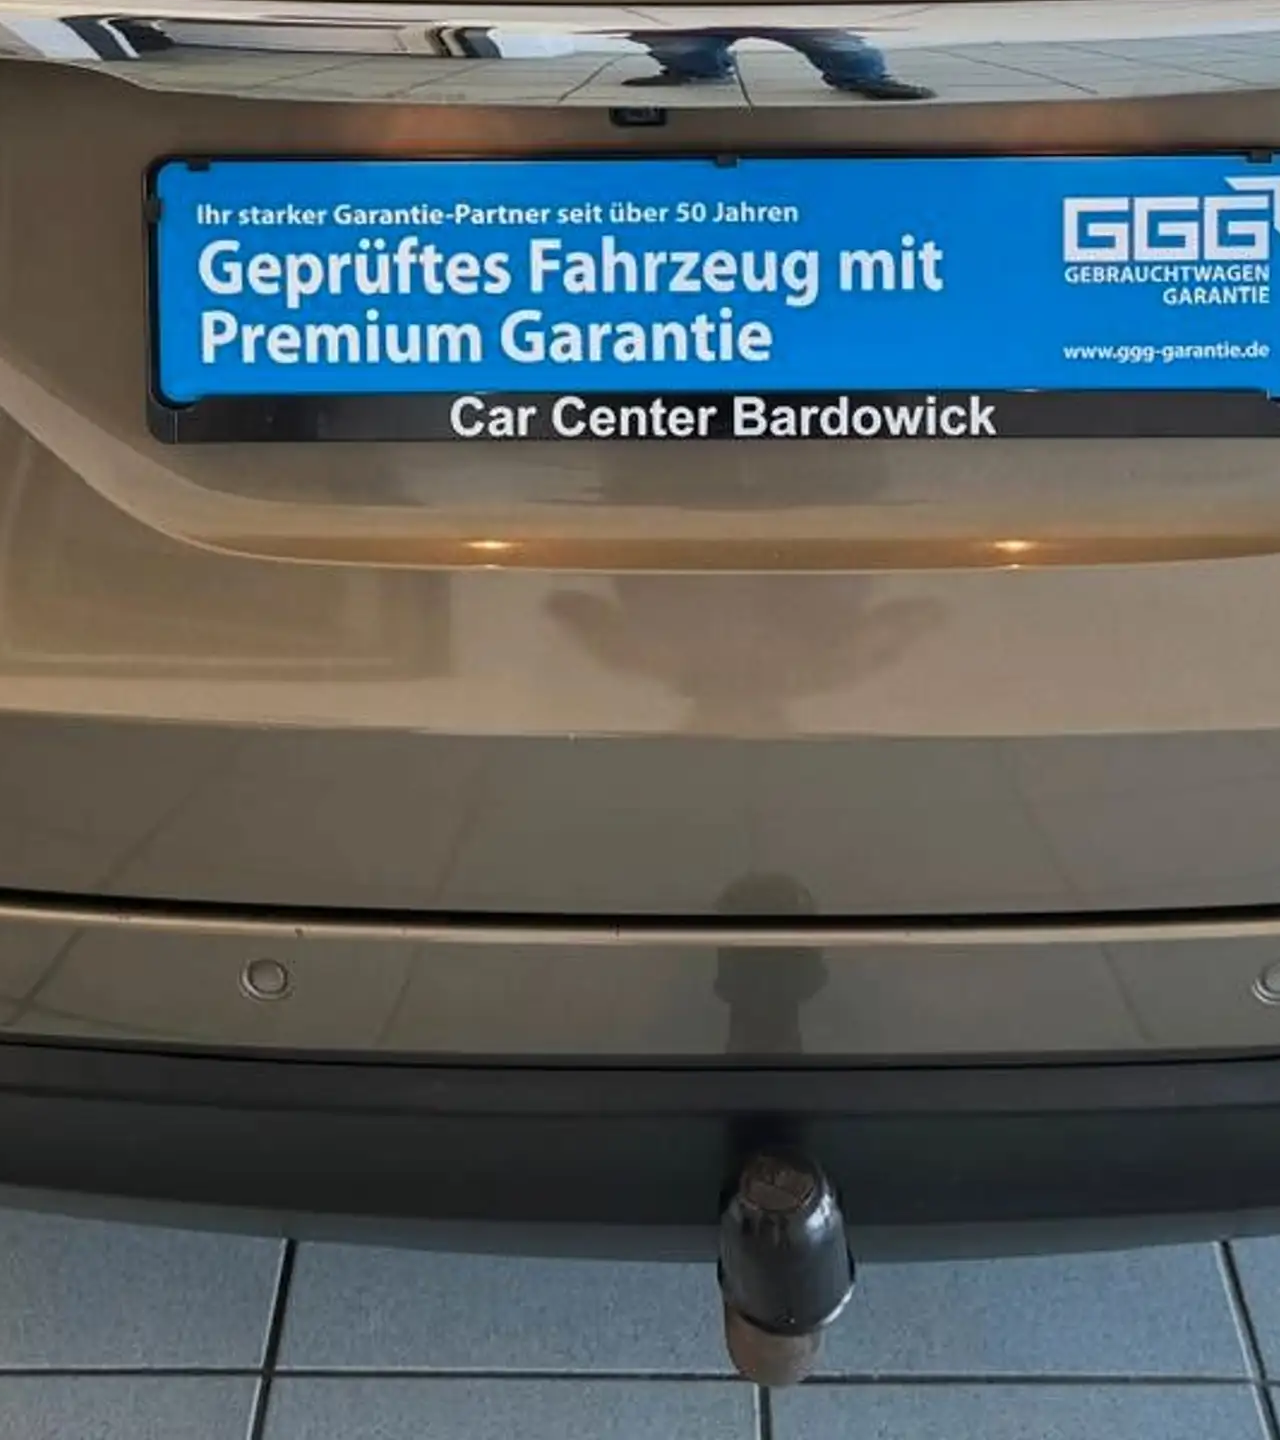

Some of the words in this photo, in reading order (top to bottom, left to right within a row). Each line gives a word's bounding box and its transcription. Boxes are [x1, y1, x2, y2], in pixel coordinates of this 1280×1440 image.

[197, 203, 231, 224] Ihr
[237, 204, 327, 225] starker
[333, 203, 551, 225] Garantie-Partner
[557, 203, 602, 224] seit
[610, 201, 668, 224] über
[676, 203, 707, 223] 50
[713, 201, 799, 223] Jahren
[1063, 194, 1270, 262] GGG
[198, 236, 512, 308] Geprüftes
[529, 236, 819, 307] Fahrzeug
[839, 235, 945, 292] mit
[1064, 264, 1270, 283] GEBRAUCHTWAGEN
[1163, 286, 1270, 305] GARANTIE
[201, 308, 482, 364] Premium
[501, 307, 773, 363] Garantie
[1063, 341, 1271, 363] www.ggg-garantie.de
[449, 396, 536, 438] Car
[551, 396, 718, 438] Center
[733, 396, 997, 438] Bardowick
